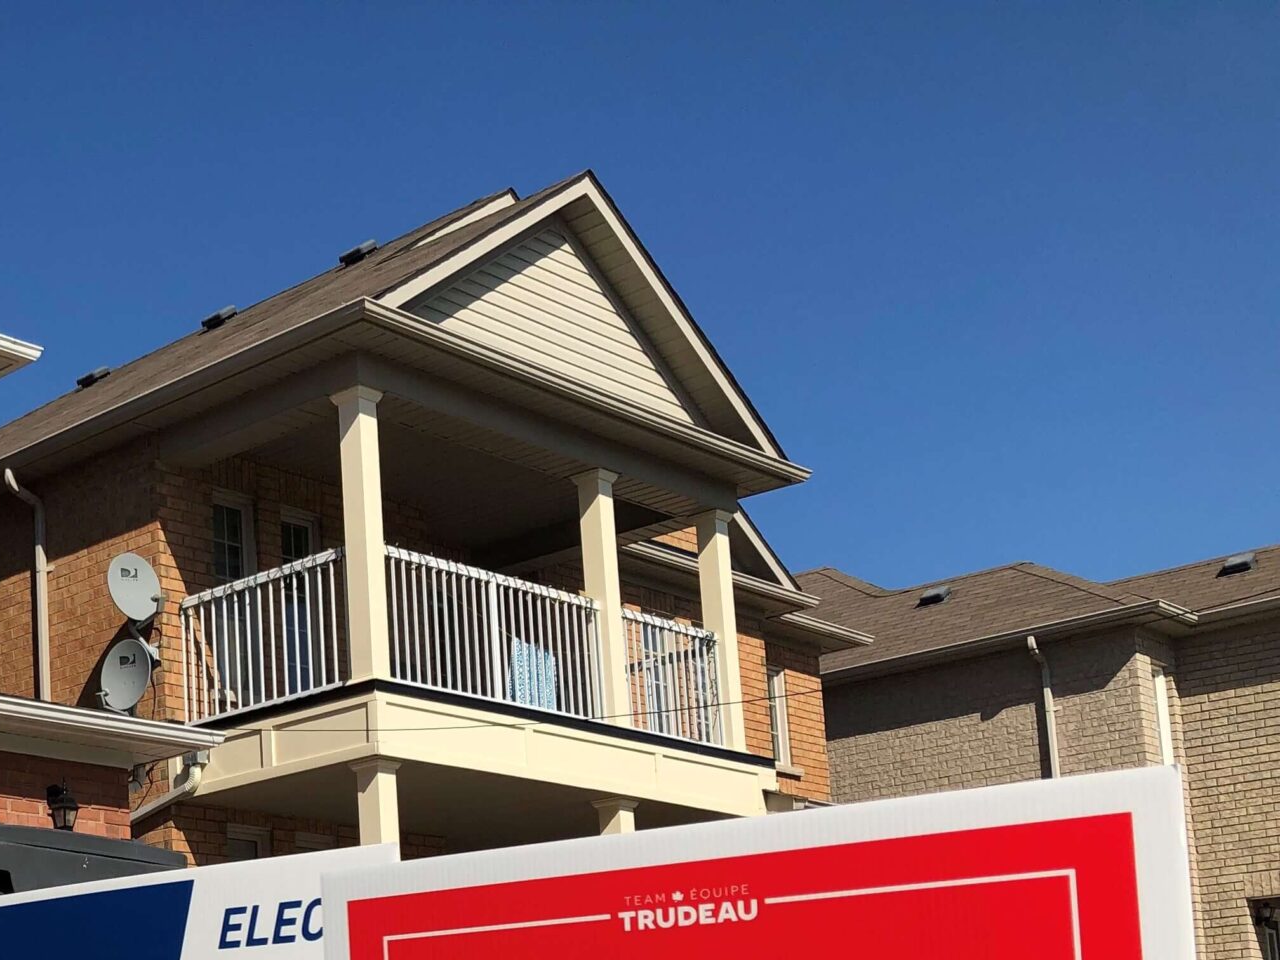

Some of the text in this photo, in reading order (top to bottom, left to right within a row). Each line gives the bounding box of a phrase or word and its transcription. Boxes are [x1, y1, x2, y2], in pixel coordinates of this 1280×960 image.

[624, 884, 749, 906] TEAM ÉQUIPE
[217, 897, 324, 950] ELEC
[618, 899, 758, 932] TRUDEAU
